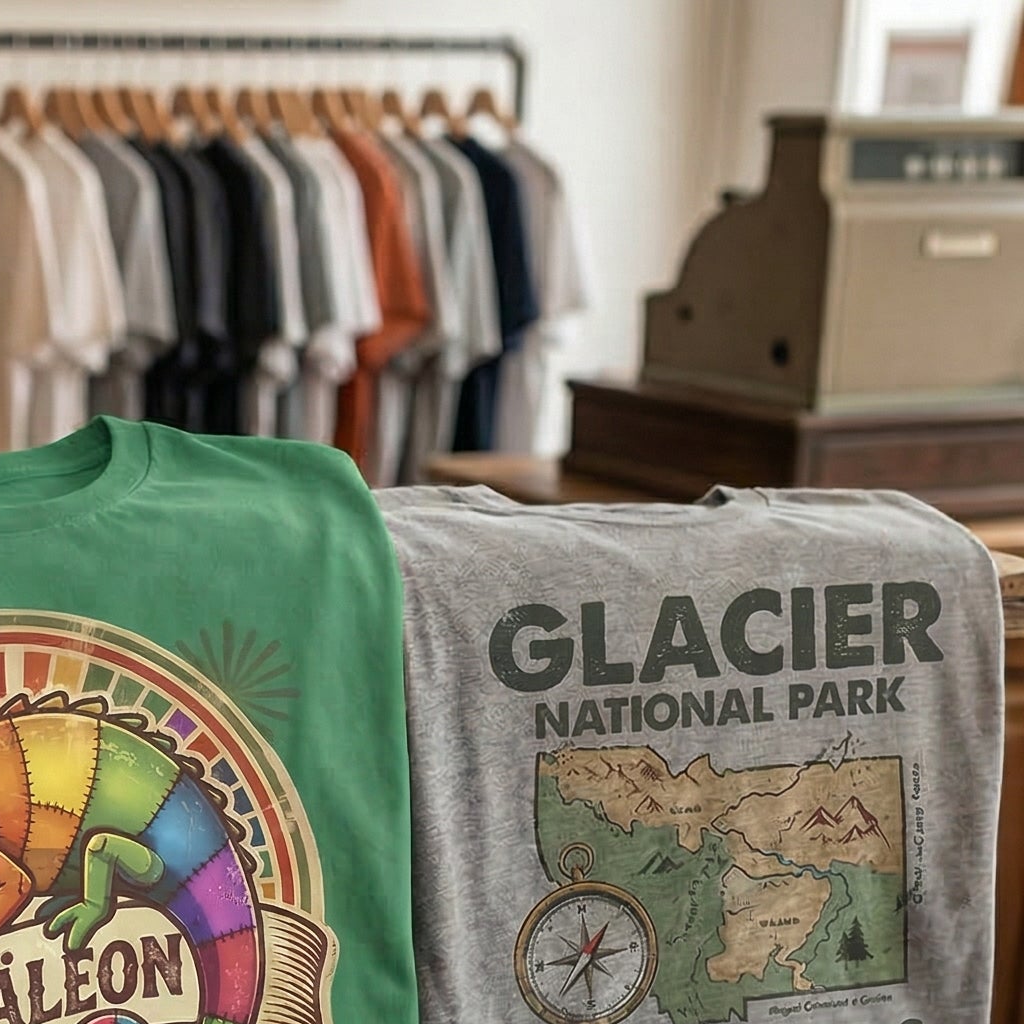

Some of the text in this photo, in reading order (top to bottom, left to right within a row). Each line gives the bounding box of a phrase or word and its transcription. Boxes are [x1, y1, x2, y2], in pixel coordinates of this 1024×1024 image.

[489, 581, 944, 692] GLACIER
[535, 676, 906, 739] NATIONAL PARK
